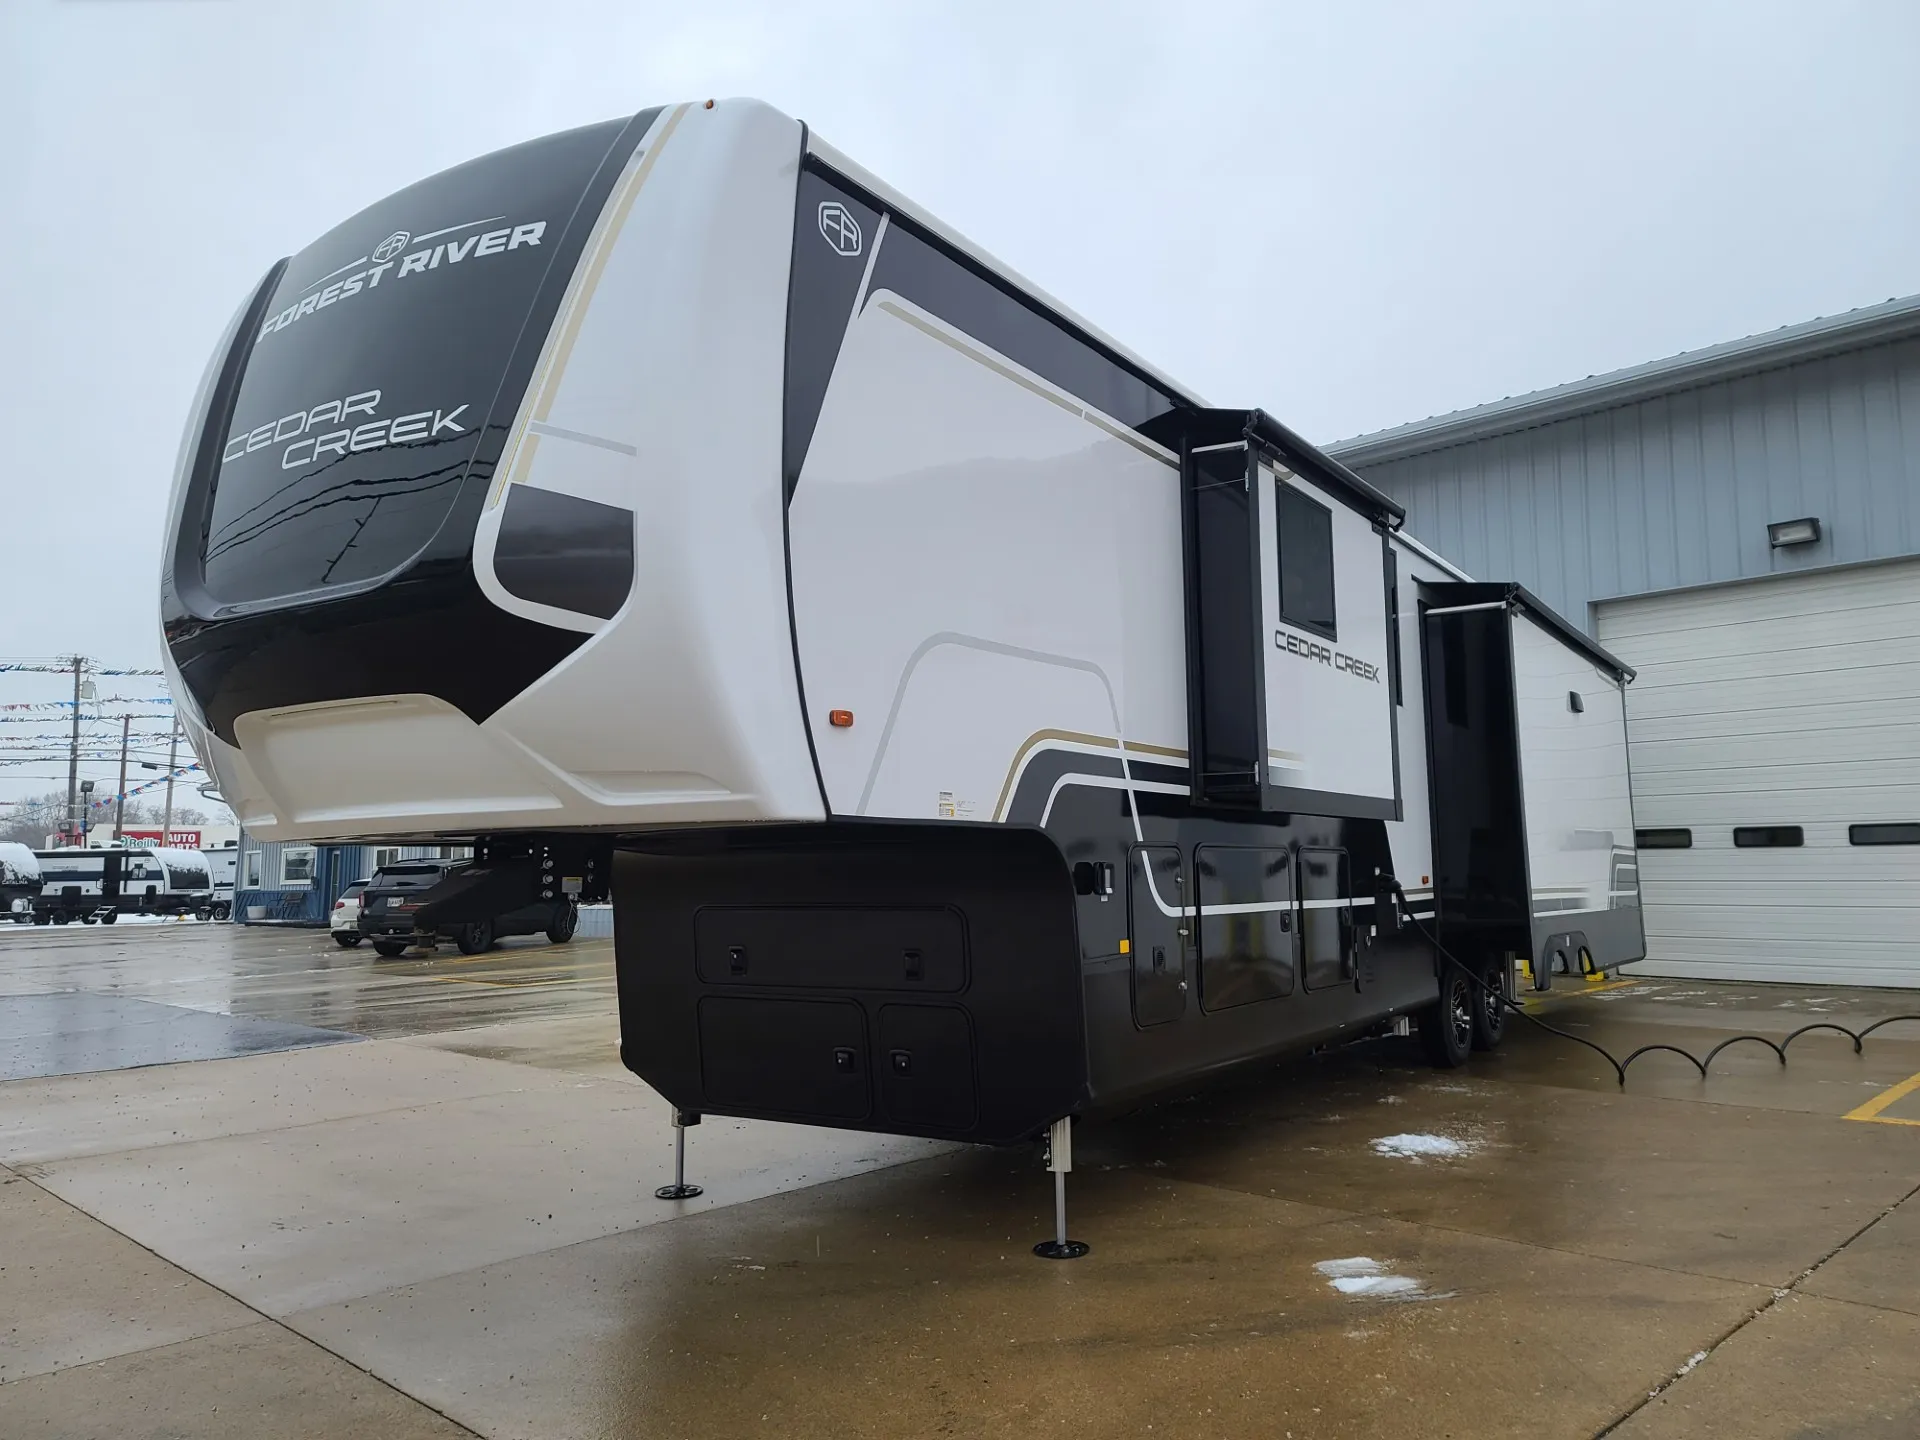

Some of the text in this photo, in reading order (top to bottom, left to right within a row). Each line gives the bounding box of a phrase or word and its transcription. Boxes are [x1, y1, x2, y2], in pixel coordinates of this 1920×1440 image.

[257, 221, 547, 343] FOREST RIVER
[222, 389, 382, 463] CEDAR
[281, 404, 470, 470] CREEK
[1274, 629, 1380, 684] CEDAR CREEK
[168, 834, 196, 843] AUTO
